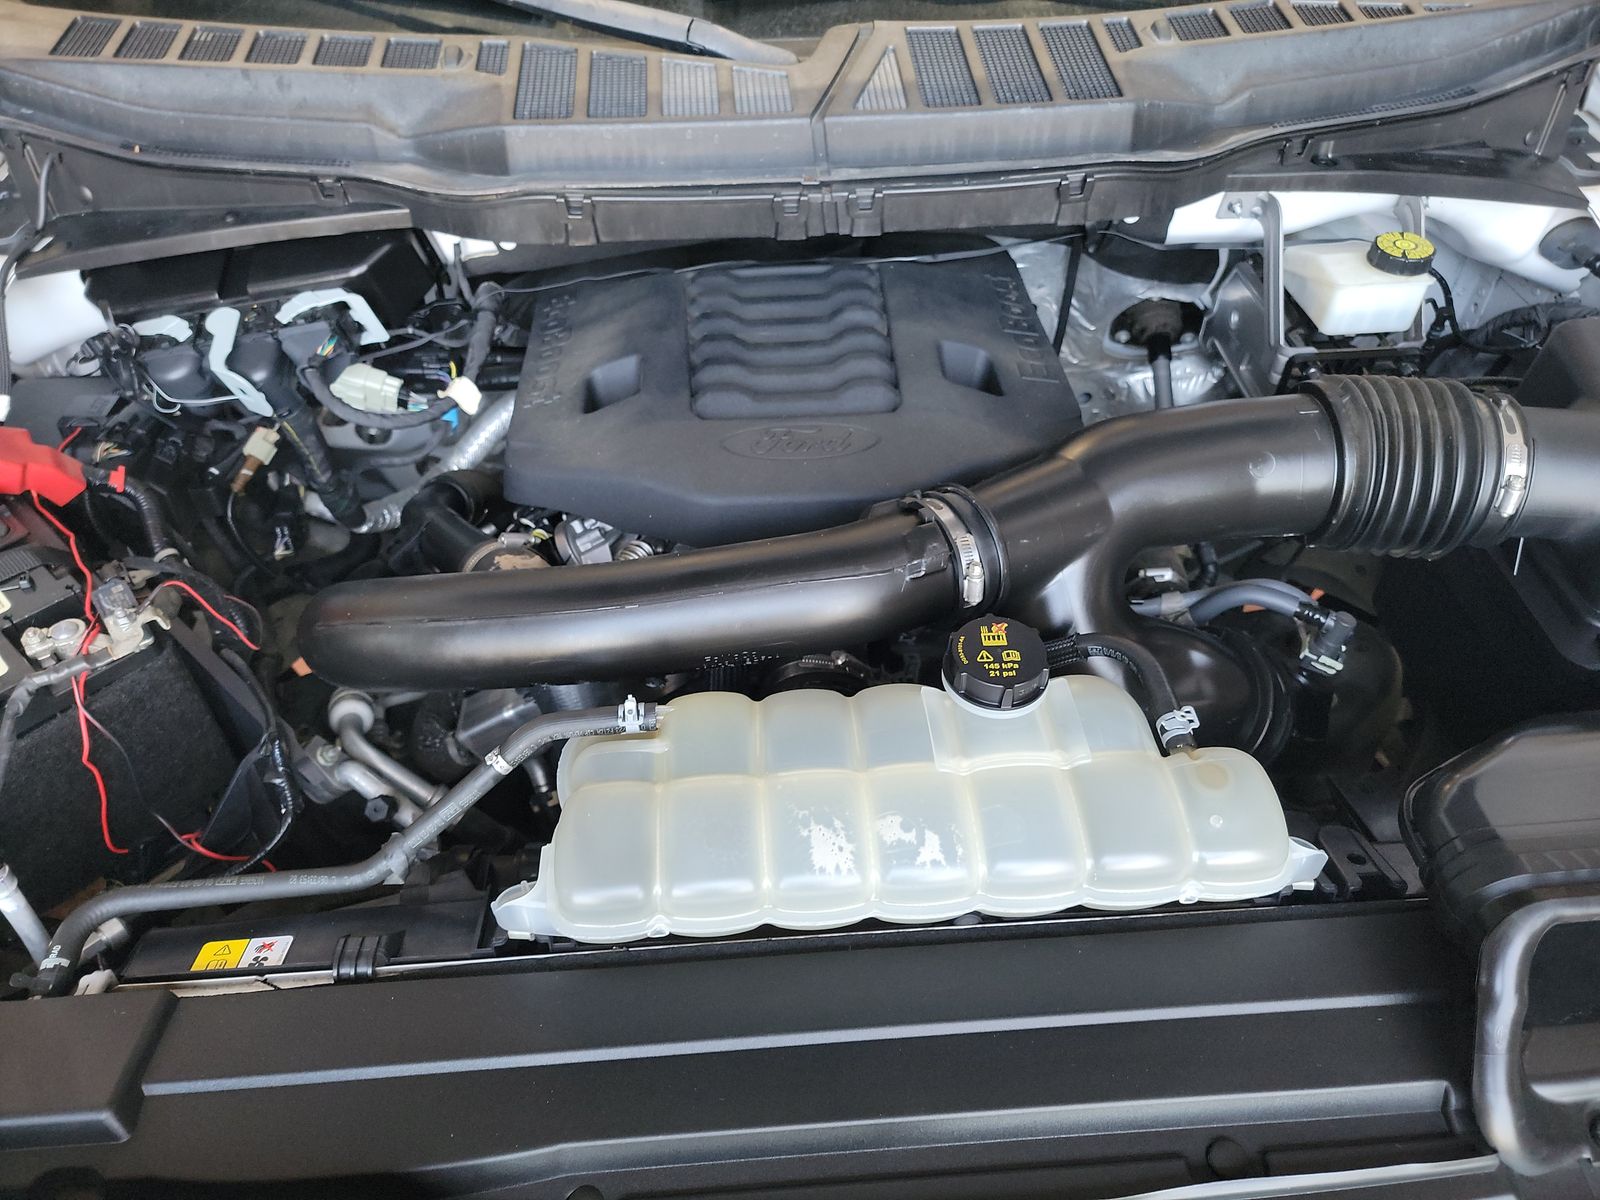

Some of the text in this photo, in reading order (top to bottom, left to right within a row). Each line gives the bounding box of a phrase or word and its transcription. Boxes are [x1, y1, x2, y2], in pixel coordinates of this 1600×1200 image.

[750, 426, 855, 456] Ford
[983, 662, 1019, 670] 145 kPa
[1003, 670, 1016, 678] psi
